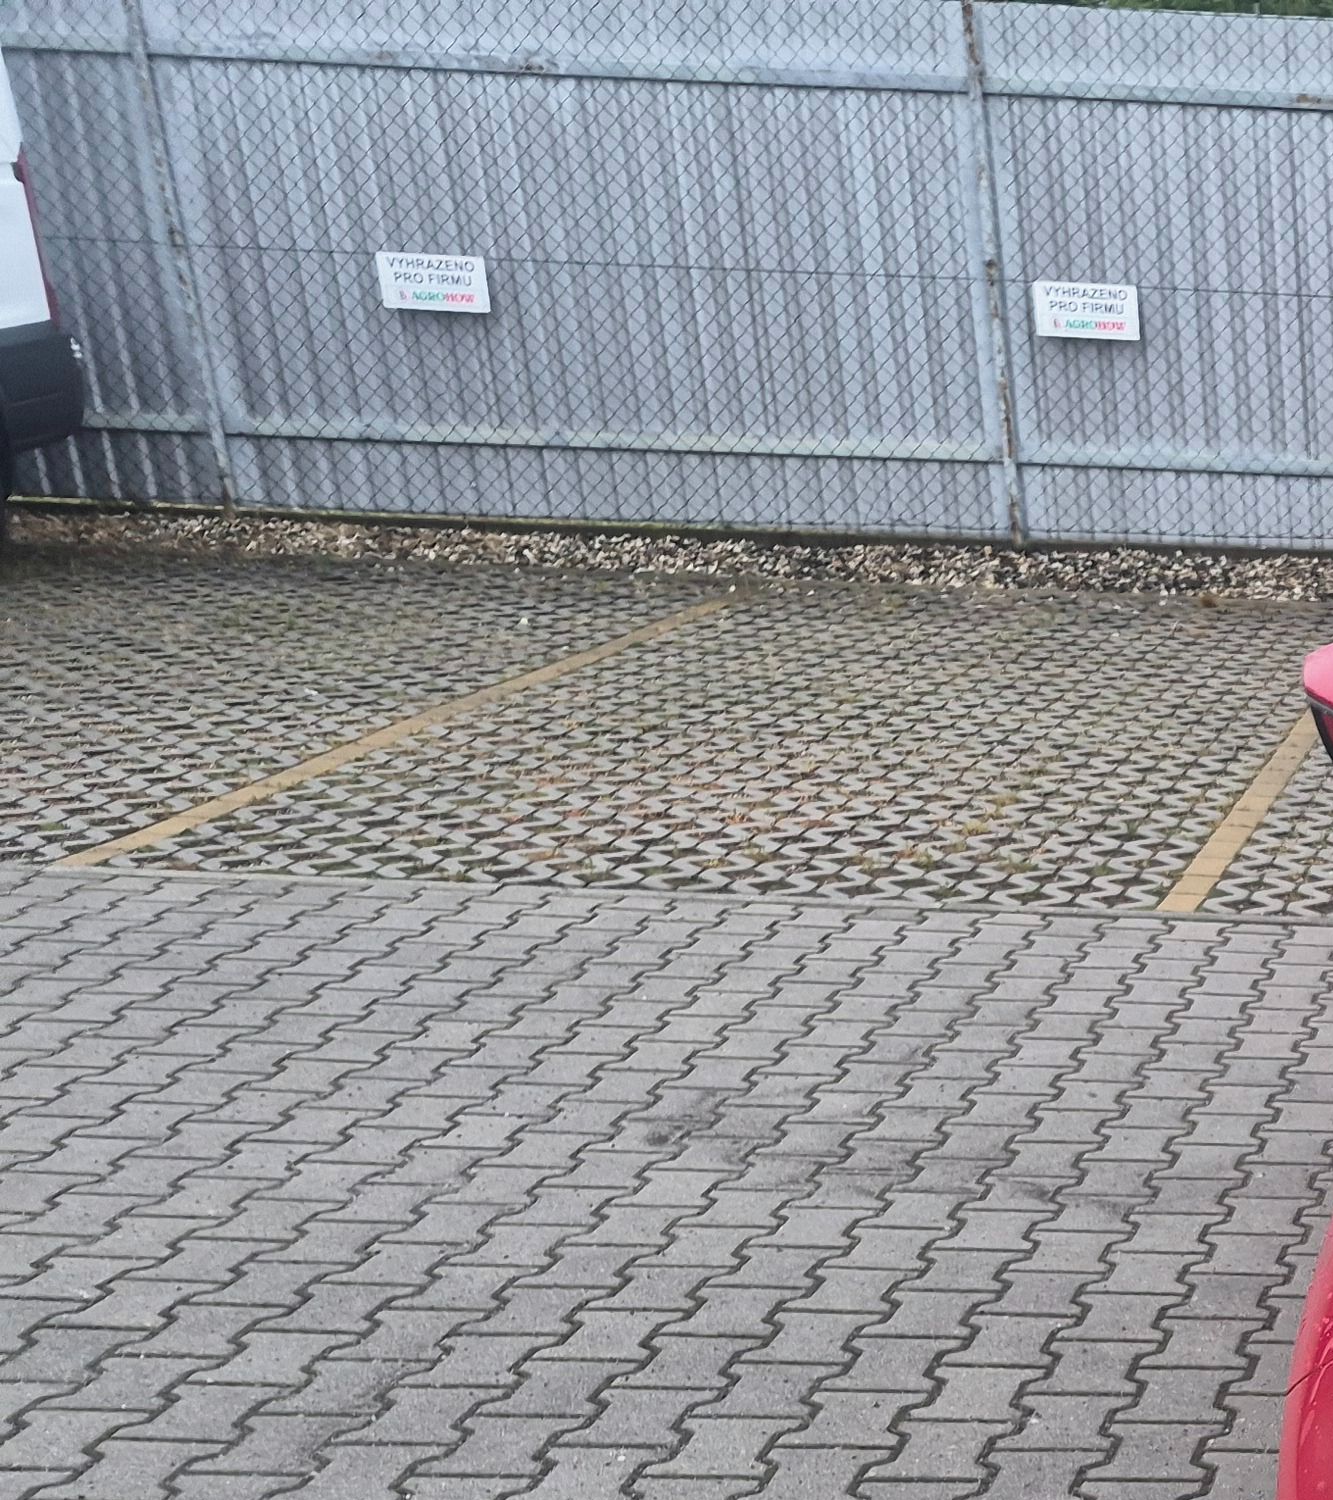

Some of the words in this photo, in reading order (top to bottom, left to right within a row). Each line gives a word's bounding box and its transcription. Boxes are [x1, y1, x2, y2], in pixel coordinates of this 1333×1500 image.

[386, 256, 475, 273] VYHRAZENO
[393, 272, 424, 284] PRO
[428, 273, 473, 287] FIRMU
[1044, 286, 1128, 301] VYHRAZENO
[1049, 300, 1079, 313] PRO
[1082, 302, 1125, 315] FIRMU
